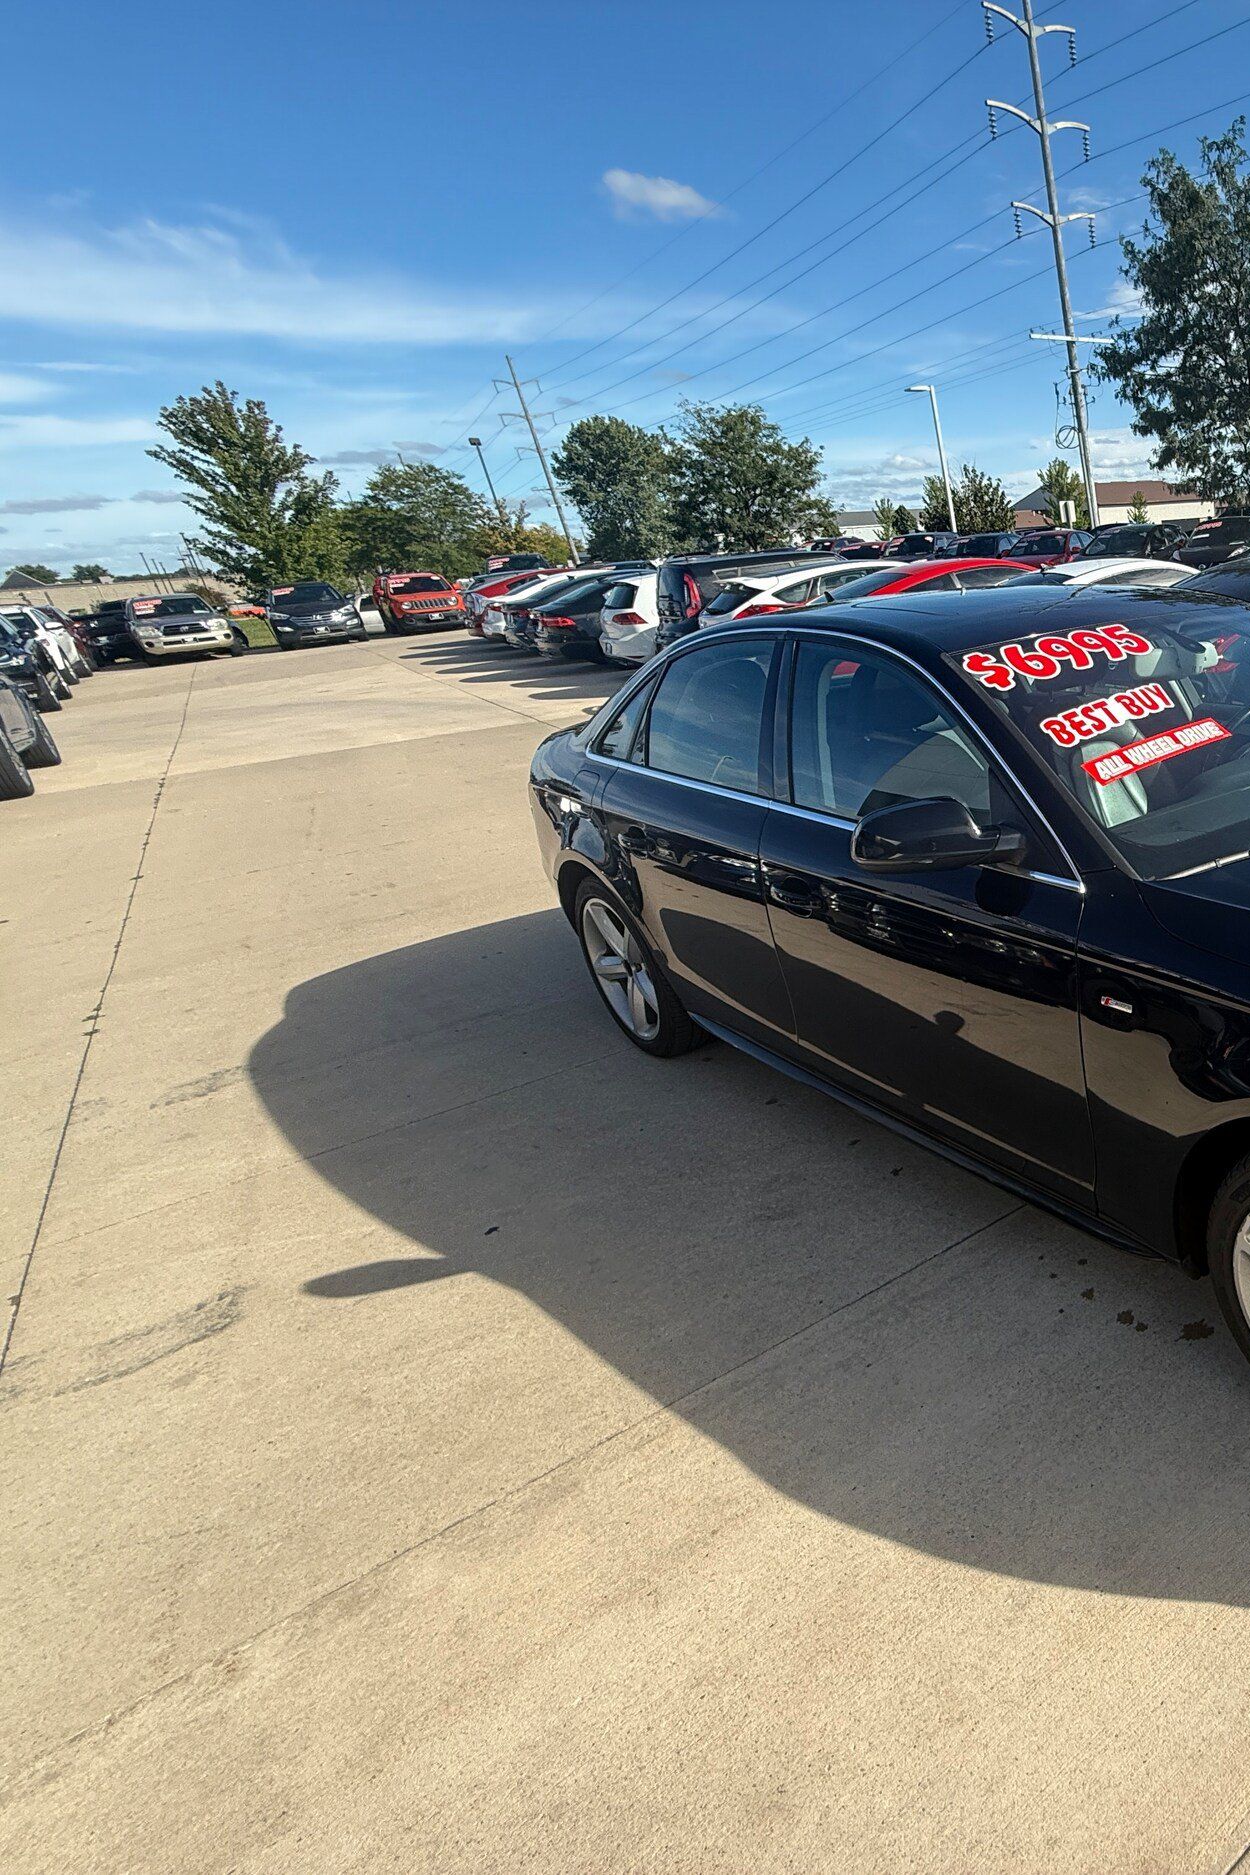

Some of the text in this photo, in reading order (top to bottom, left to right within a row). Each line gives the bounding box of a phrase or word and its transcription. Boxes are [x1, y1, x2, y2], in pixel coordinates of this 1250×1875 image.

[963, 624, 1152, 691] $6995
[1041, 683, 1174, 746] BEST BUY
[1094, 720, 1224, 781] ALL WHEEL DRIVE
